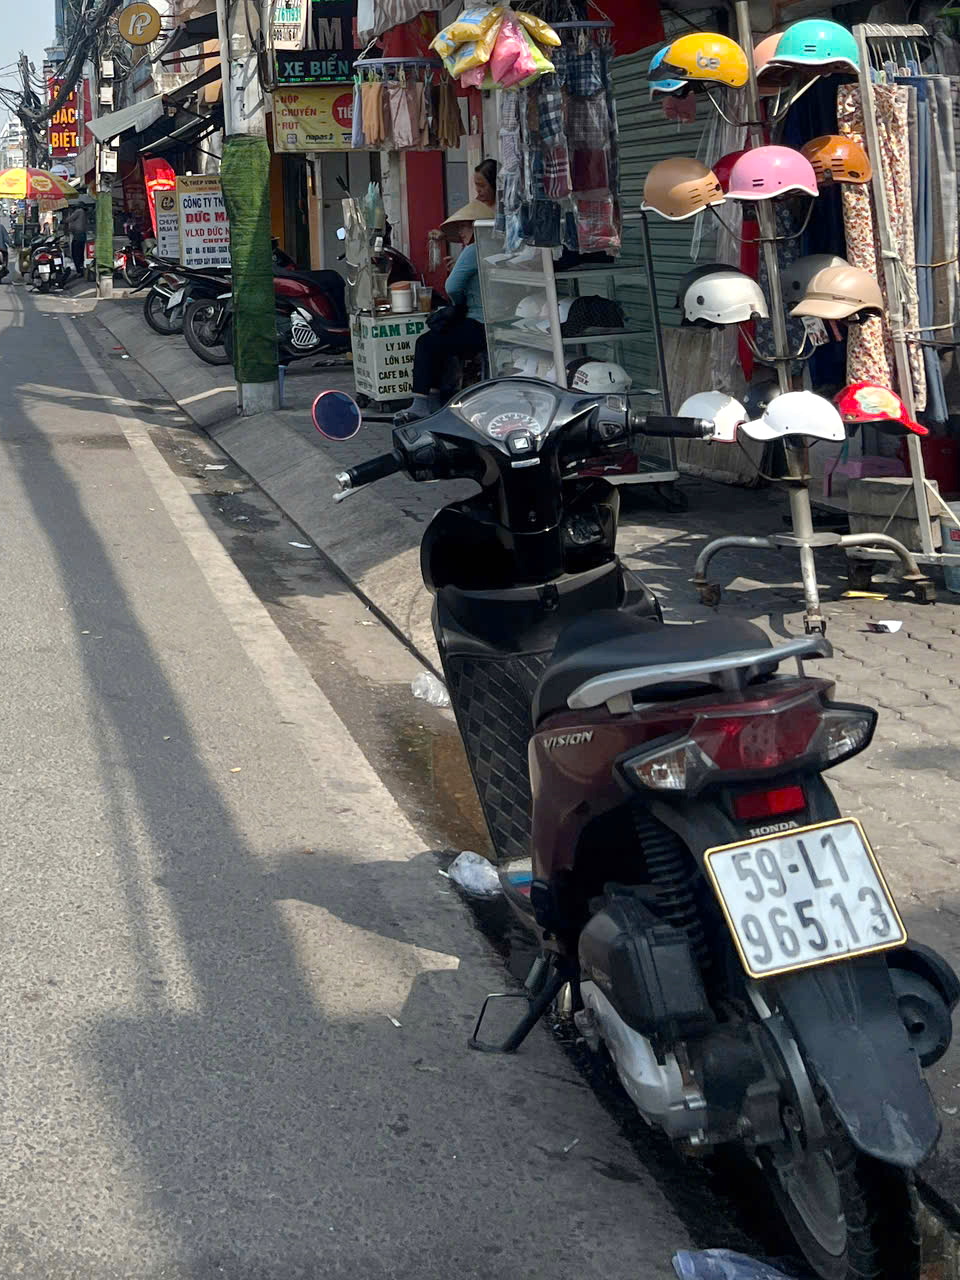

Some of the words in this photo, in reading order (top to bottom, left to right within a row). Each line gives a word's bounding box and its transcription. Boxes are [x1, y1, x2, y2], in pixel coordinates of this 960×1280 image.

[695, 48, 721, 70] be
[283, 61, 305, 77] XE
[51, 129, 77, 151] BIỆT
[183, 195, 202, 208] CÔNG
[203, 197, 212, 208] TY
[371, 323, 401, 338] CAM
[406, 319, 424, 335] ÉP
[386, 342, 394, 351] LY
[397, 341, 411, 351] 10K
[379, 370, 397, 380] CAFE
[378, 384, 397, 394] CAFE
[543, 730, 594, 752] VISION
[749, 820, 800, 838] HONDA
[731, 832, 850, 903] 59-L1
[740, 886, 891, 966] 965.13
